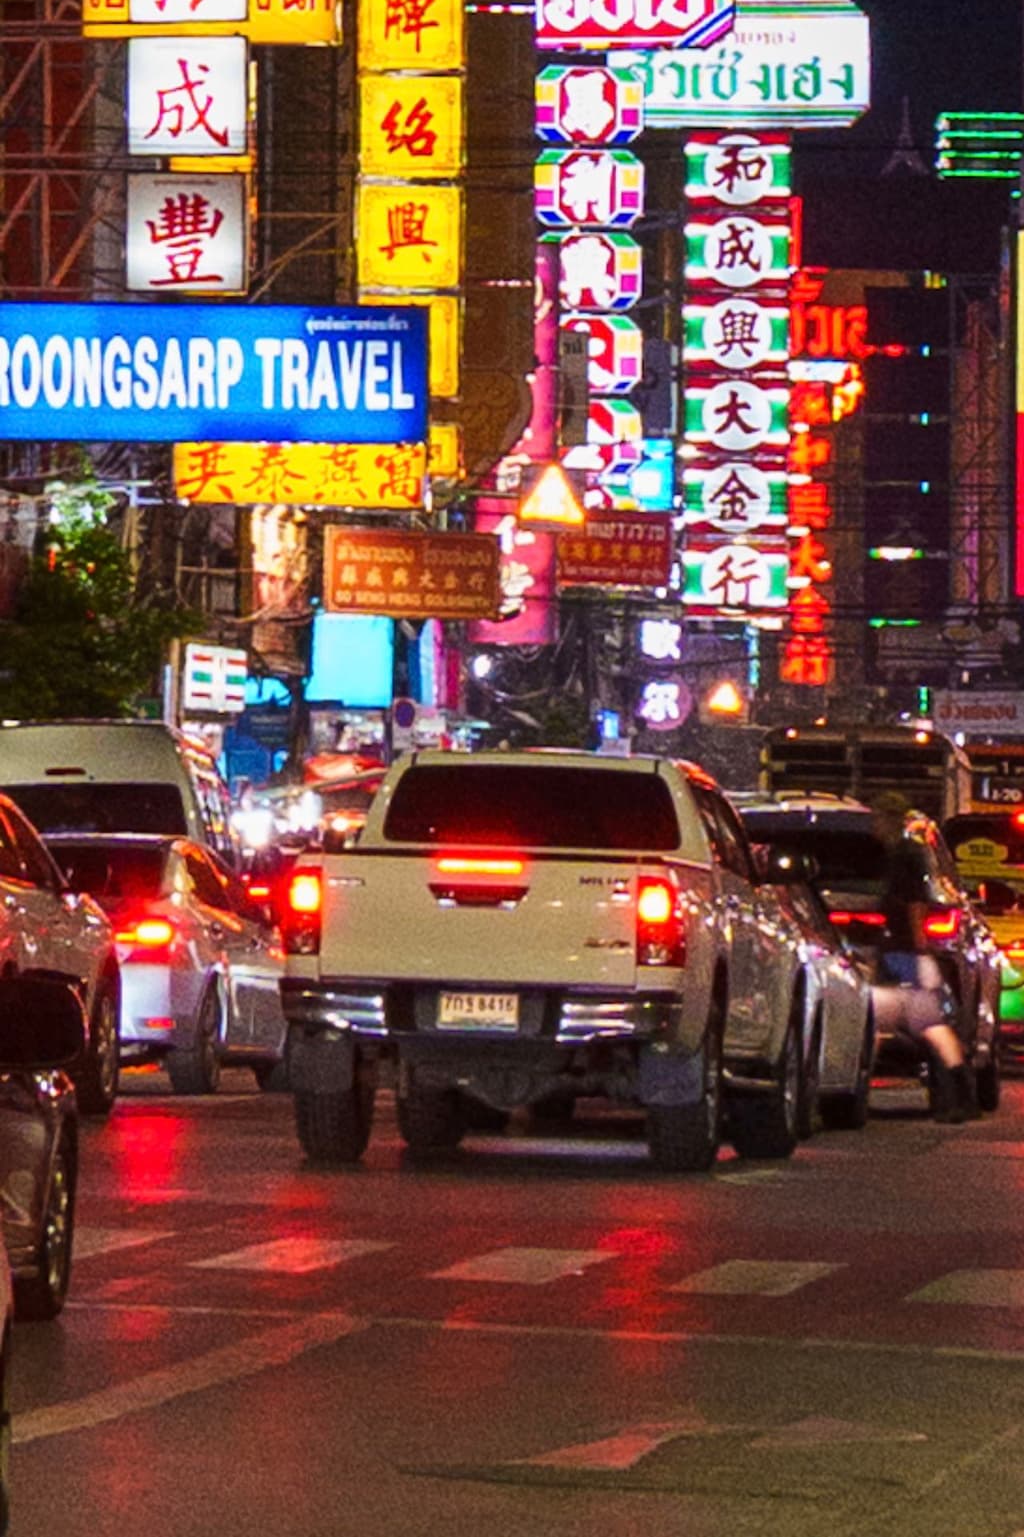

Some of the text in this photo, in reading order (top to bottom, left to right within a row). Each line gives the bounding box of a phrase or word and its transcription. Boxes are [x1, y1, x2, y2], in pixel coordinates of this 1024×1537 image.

[254, 338, 415, 411] TRAVEL
[713, 146, 767, 606] 和成興大金行
